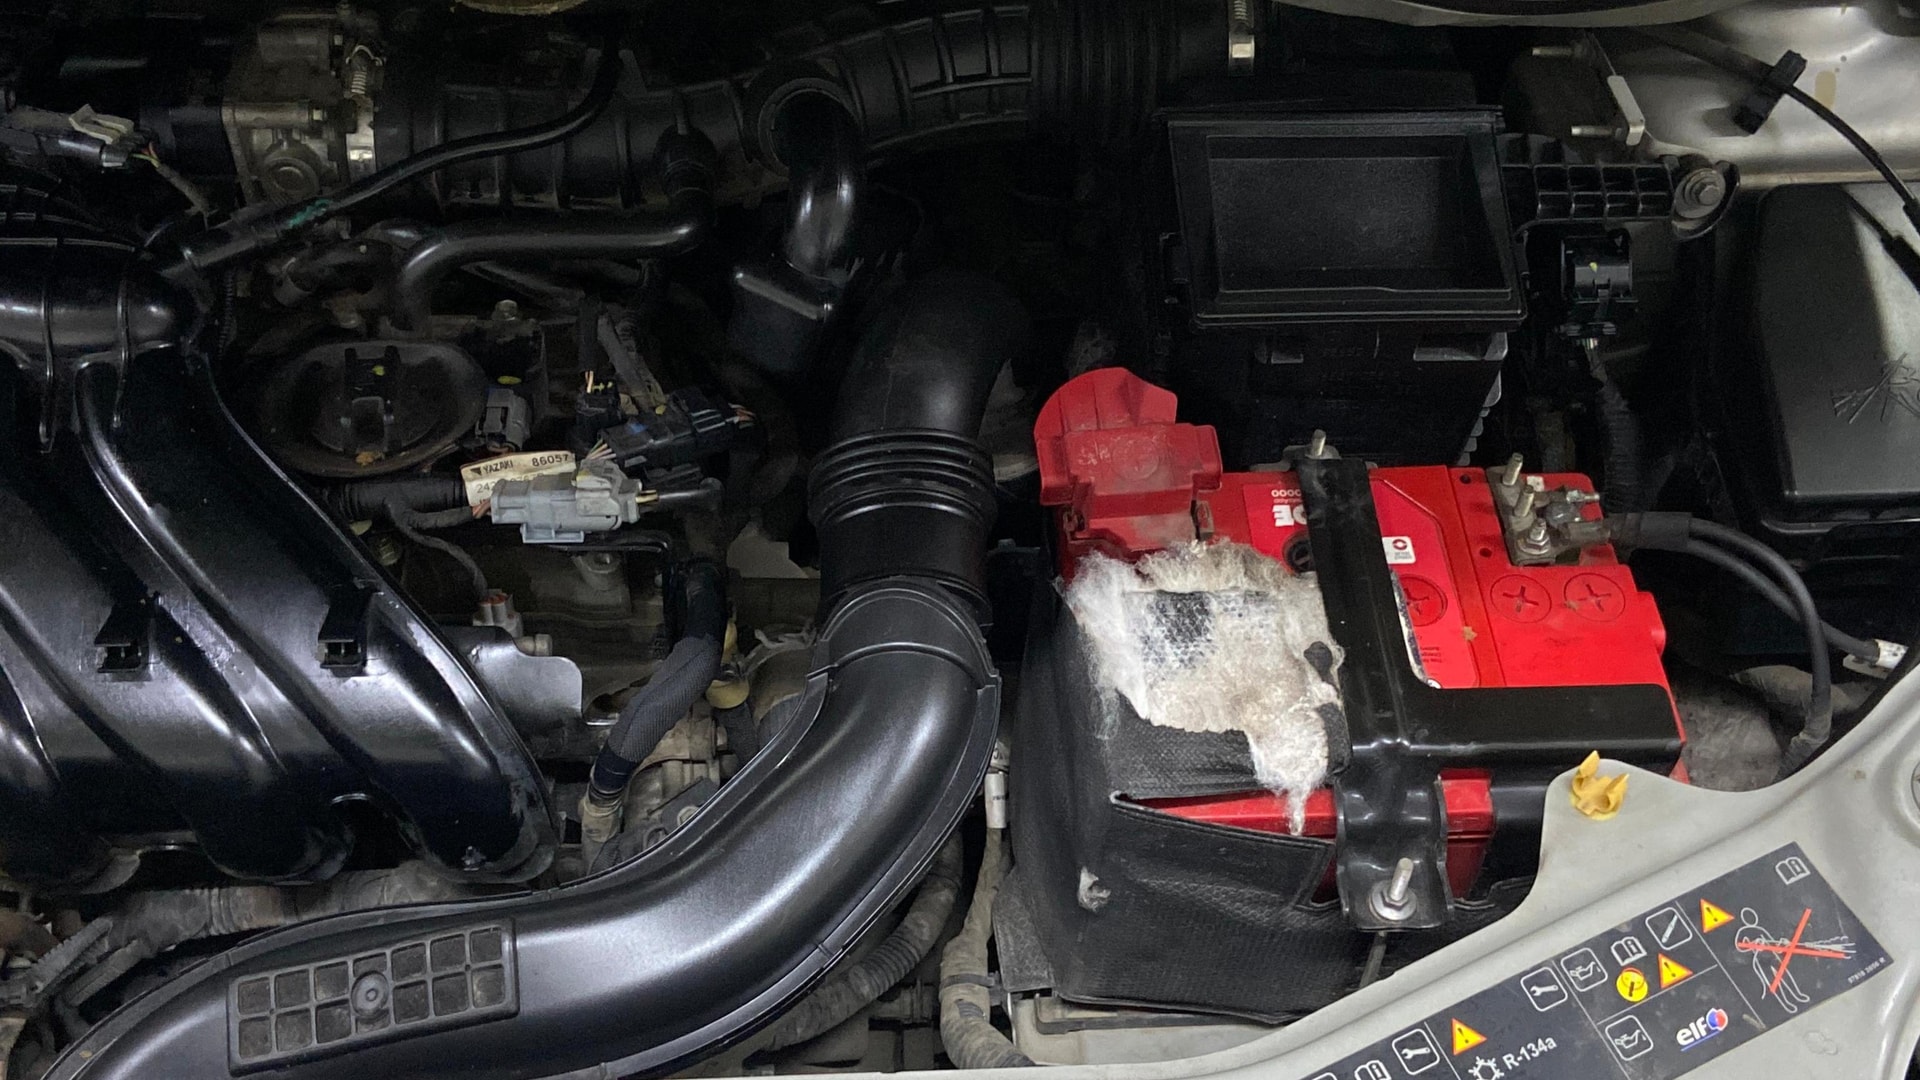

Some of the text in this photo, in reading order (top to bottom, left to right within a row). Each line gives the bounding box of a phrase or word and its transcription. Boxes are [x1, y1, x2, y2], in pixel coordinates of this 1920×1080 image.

[483, 453, 569, 474] YAZAKI 86057
[1675, 1016, 1708, 1047] elf
[1502, 1035, 1557, 1071] R-134a
